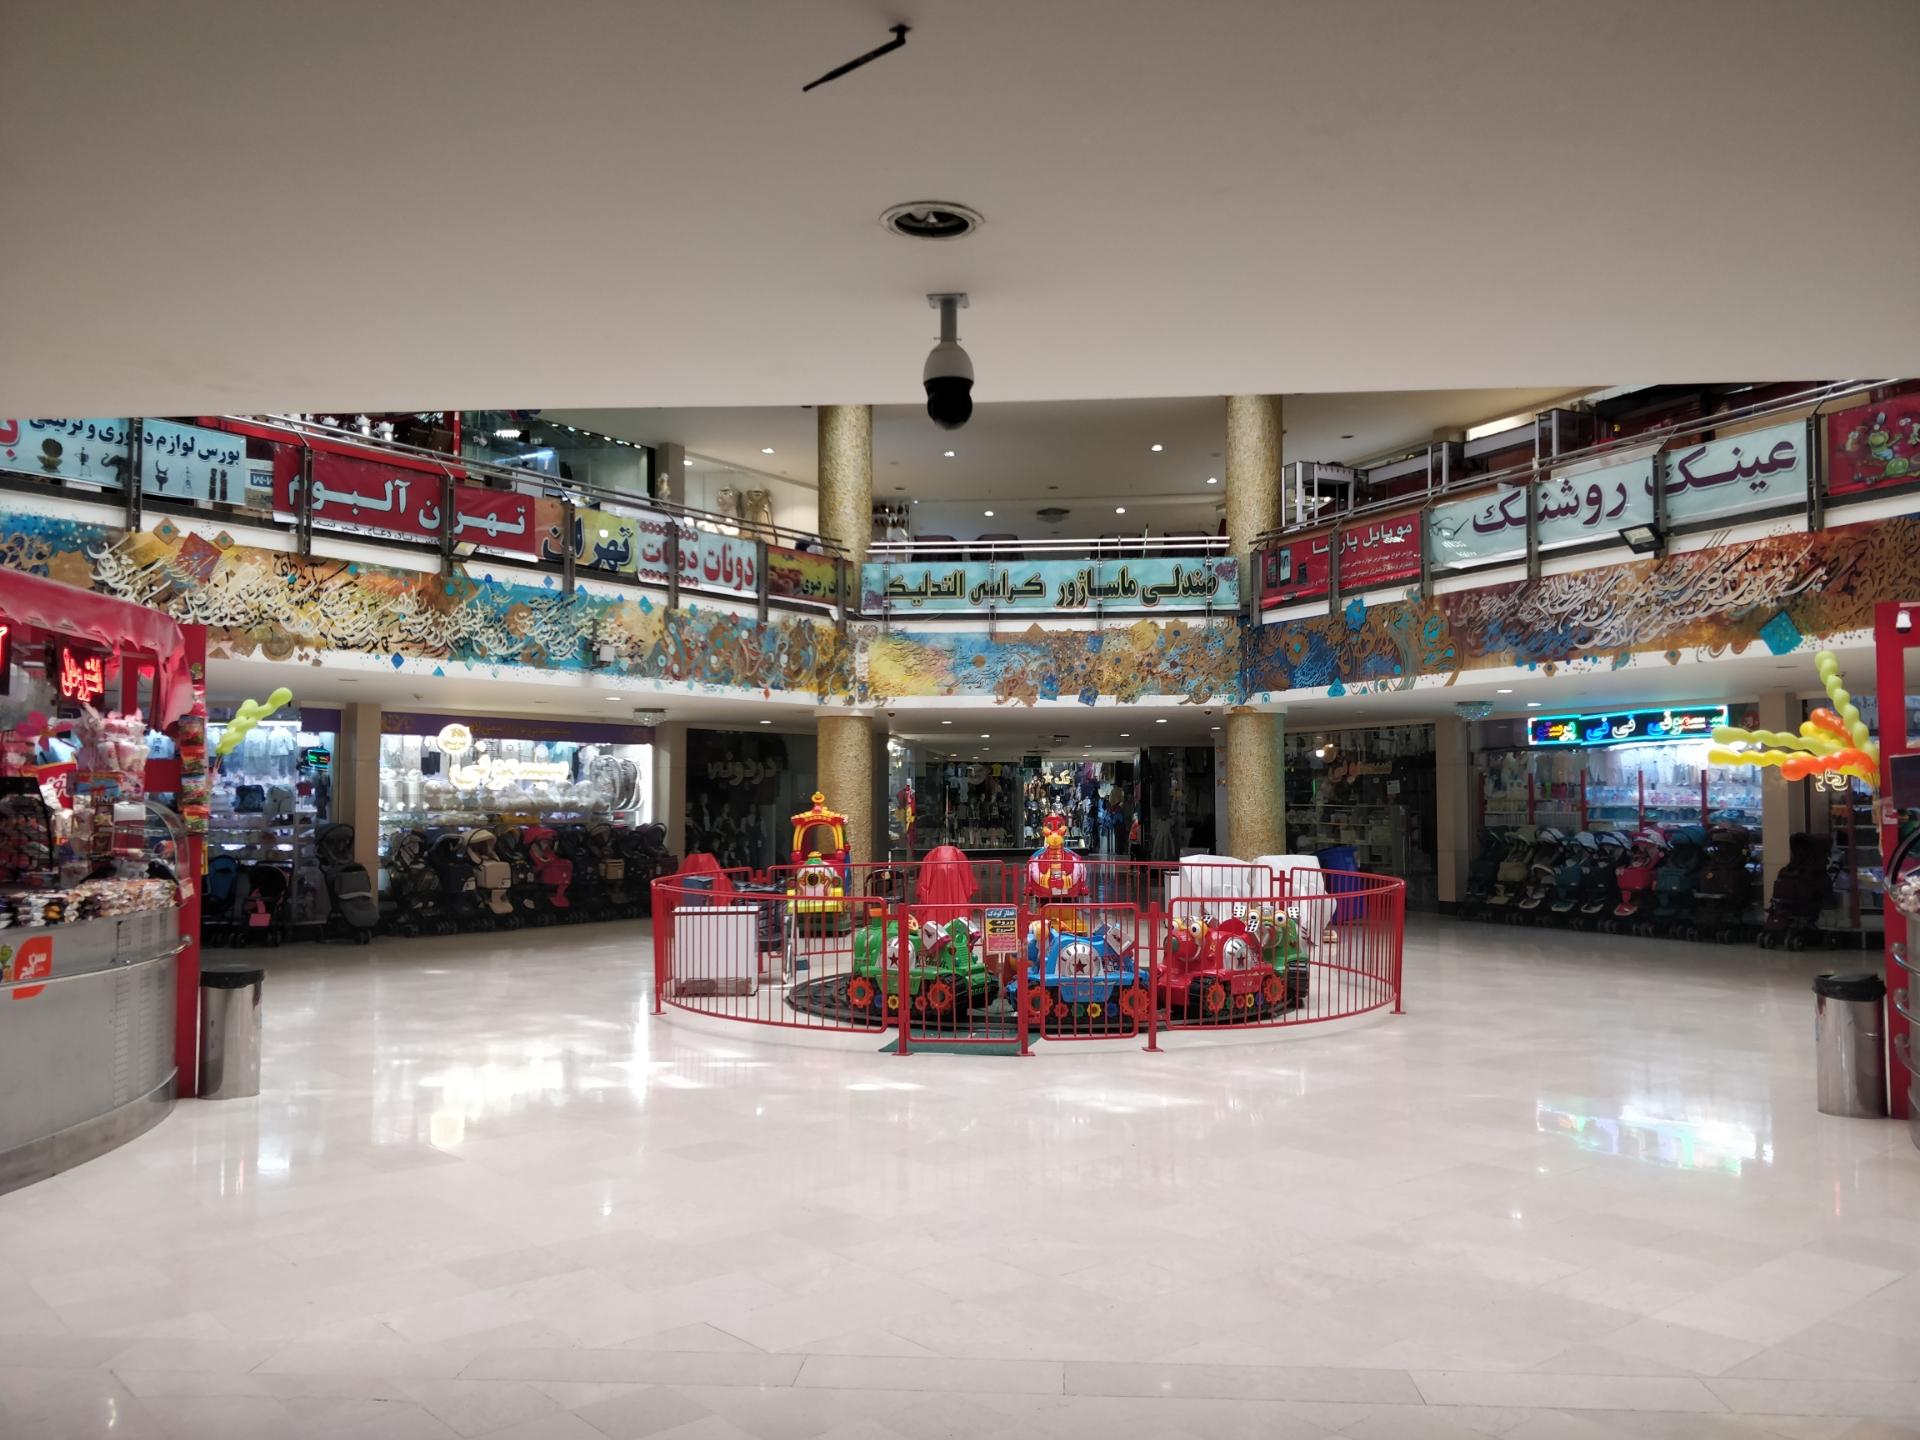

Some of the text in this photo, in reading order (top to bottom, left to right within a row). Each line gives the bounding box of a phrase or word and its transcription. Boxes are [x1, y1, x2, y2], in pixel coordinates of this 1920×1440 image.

[87, 423, 95, 440] و
[100, 426, 152, 444] دری
[156, 434, 195, 457] لوازم
[199, 446, 240, 464] بورس
[1472, 440, 1797, 534] عینک روشنک
[288, 473, 526, 538] تهرن آلبوم
[541, 516, 634, 573] تهران
[641, 541, 755, 591] دونات دوات
[1055, 566, 1138, 609] ماساژور
[1140, 564, 1219, 606] صندلی
[1585, 717, 1611, 742] نی
[1611, 713, 1636, 739] نی
[987, 910, 1003, 918] کودک
